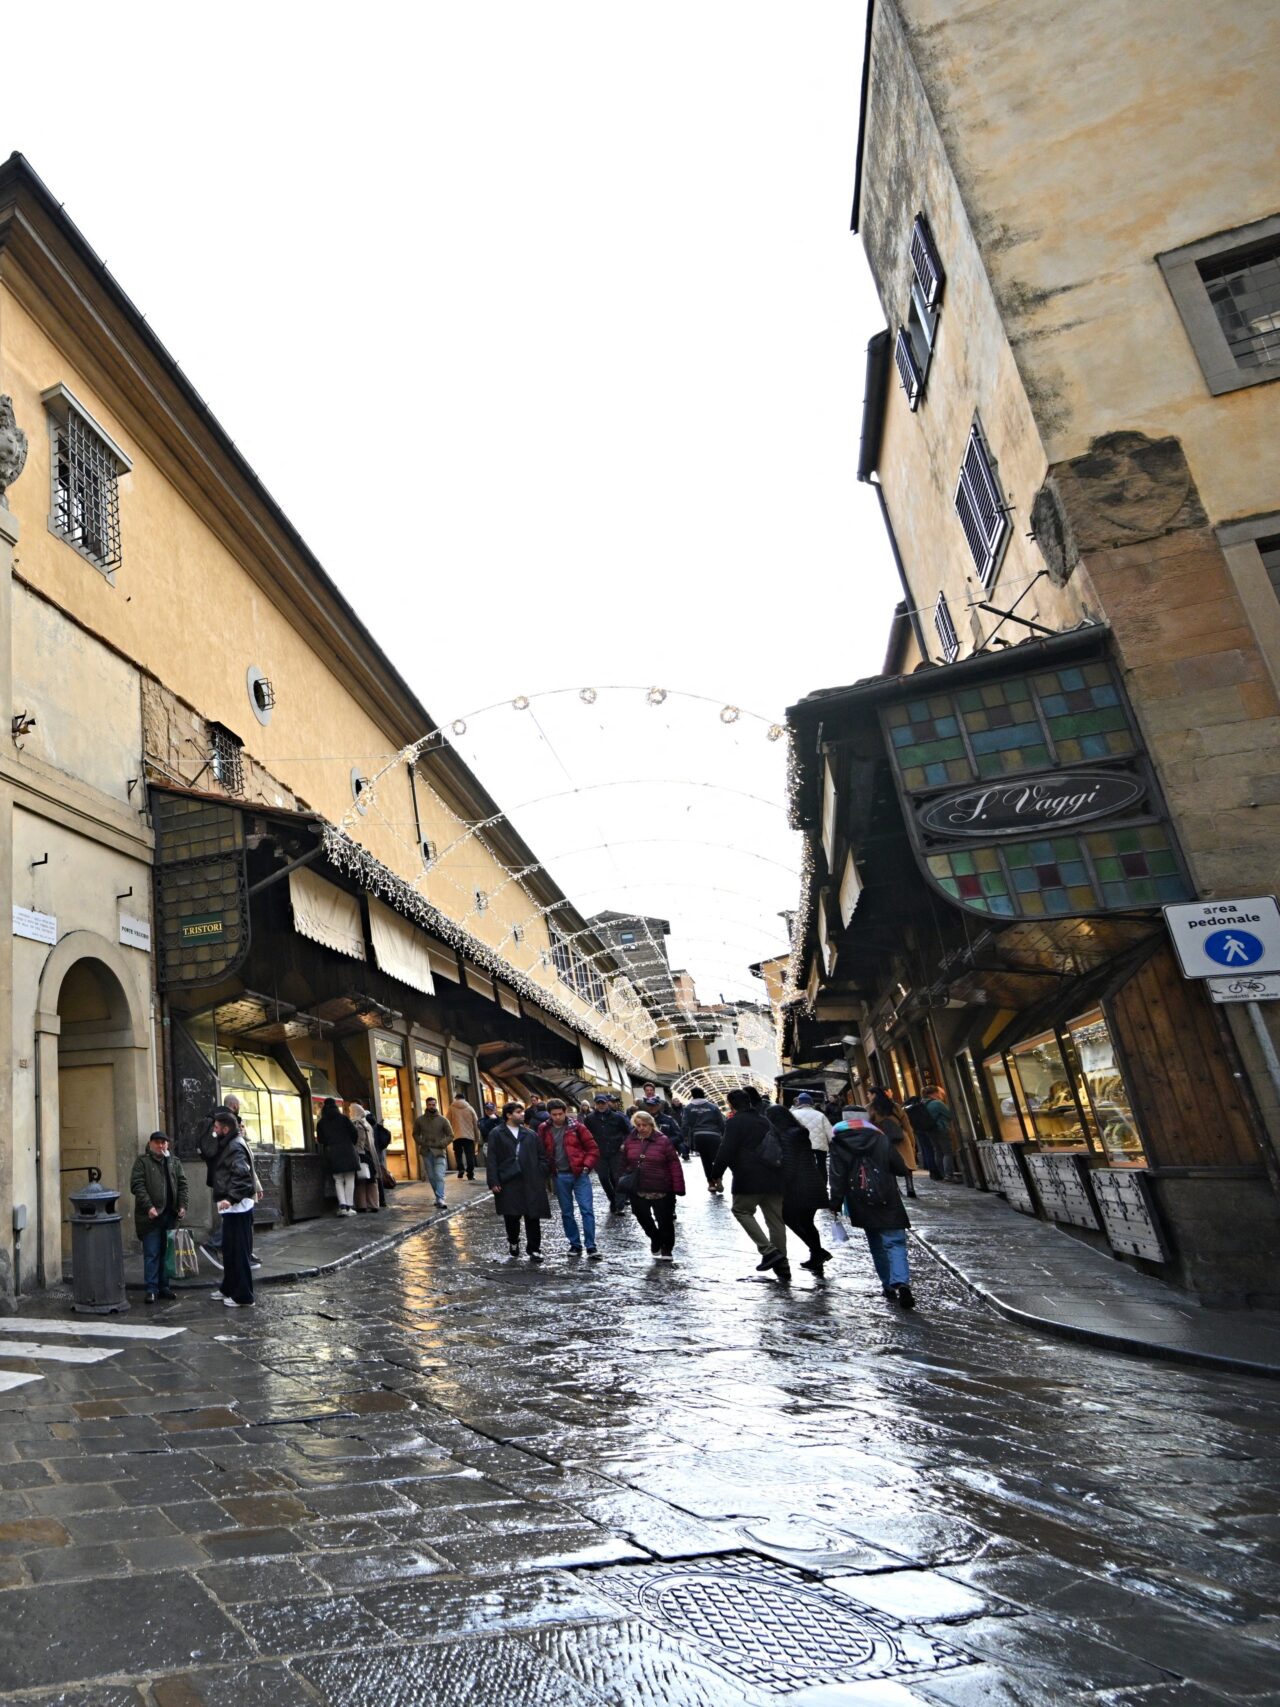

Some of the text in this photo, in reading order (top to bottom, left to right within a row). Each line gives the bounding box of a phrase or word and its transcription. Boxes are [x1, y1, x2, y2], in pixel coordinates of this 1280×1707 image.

[1002, 784, 1101, 817] Vaggi
[1203, 905, 1238, 914] area
[1188, 913, 1261, 929] pedonale
[182, 922, 223, 936] T.RISTORI
